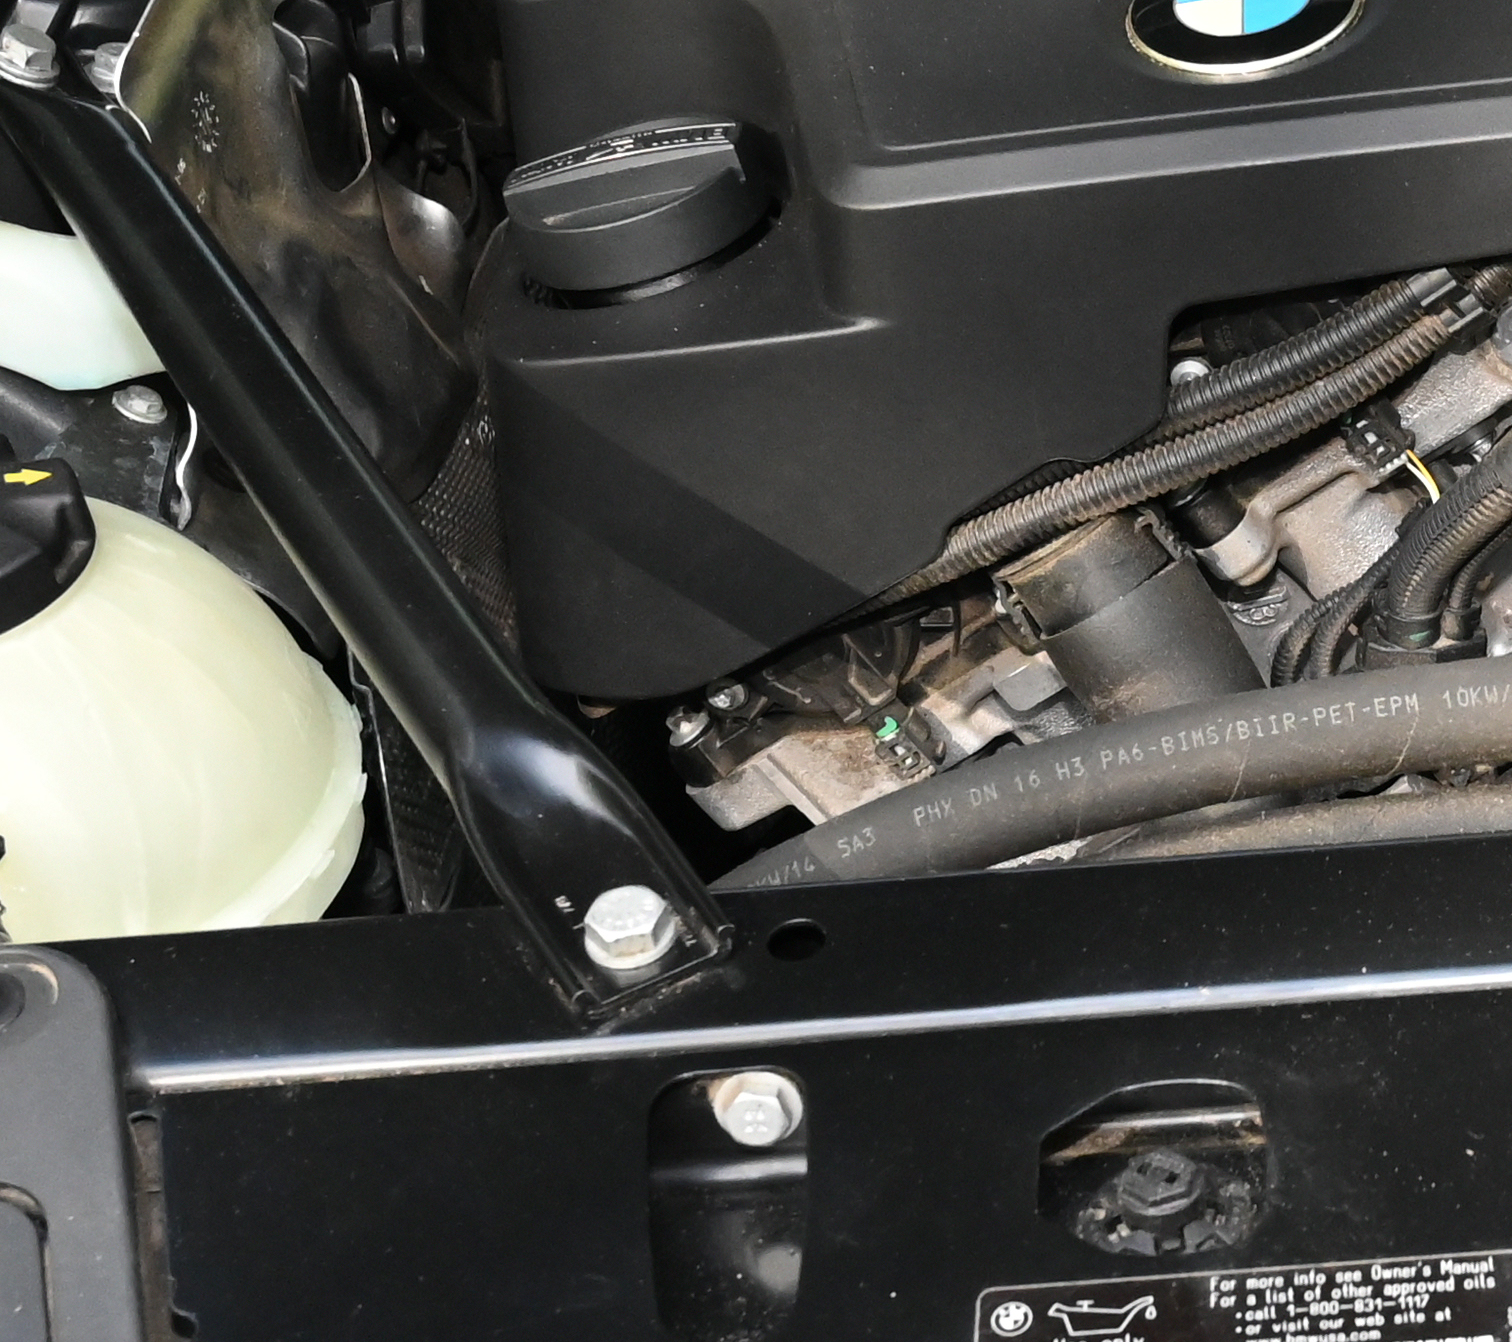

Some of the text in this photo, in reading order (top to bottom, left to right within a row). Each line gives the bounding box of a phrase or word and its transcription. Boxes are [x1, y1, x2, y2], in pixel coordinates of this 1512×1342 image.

[1014, 769, 1041, 792] 16
[1055, 756, 1086, 781] H3
[1209, 1272, 1496, 1308] For a list of other approved oils
[1210, 1255, 1495, 1292] For more info see Owner's Manual
[1245, 1306, 1451, 1336] or visit our web site at
